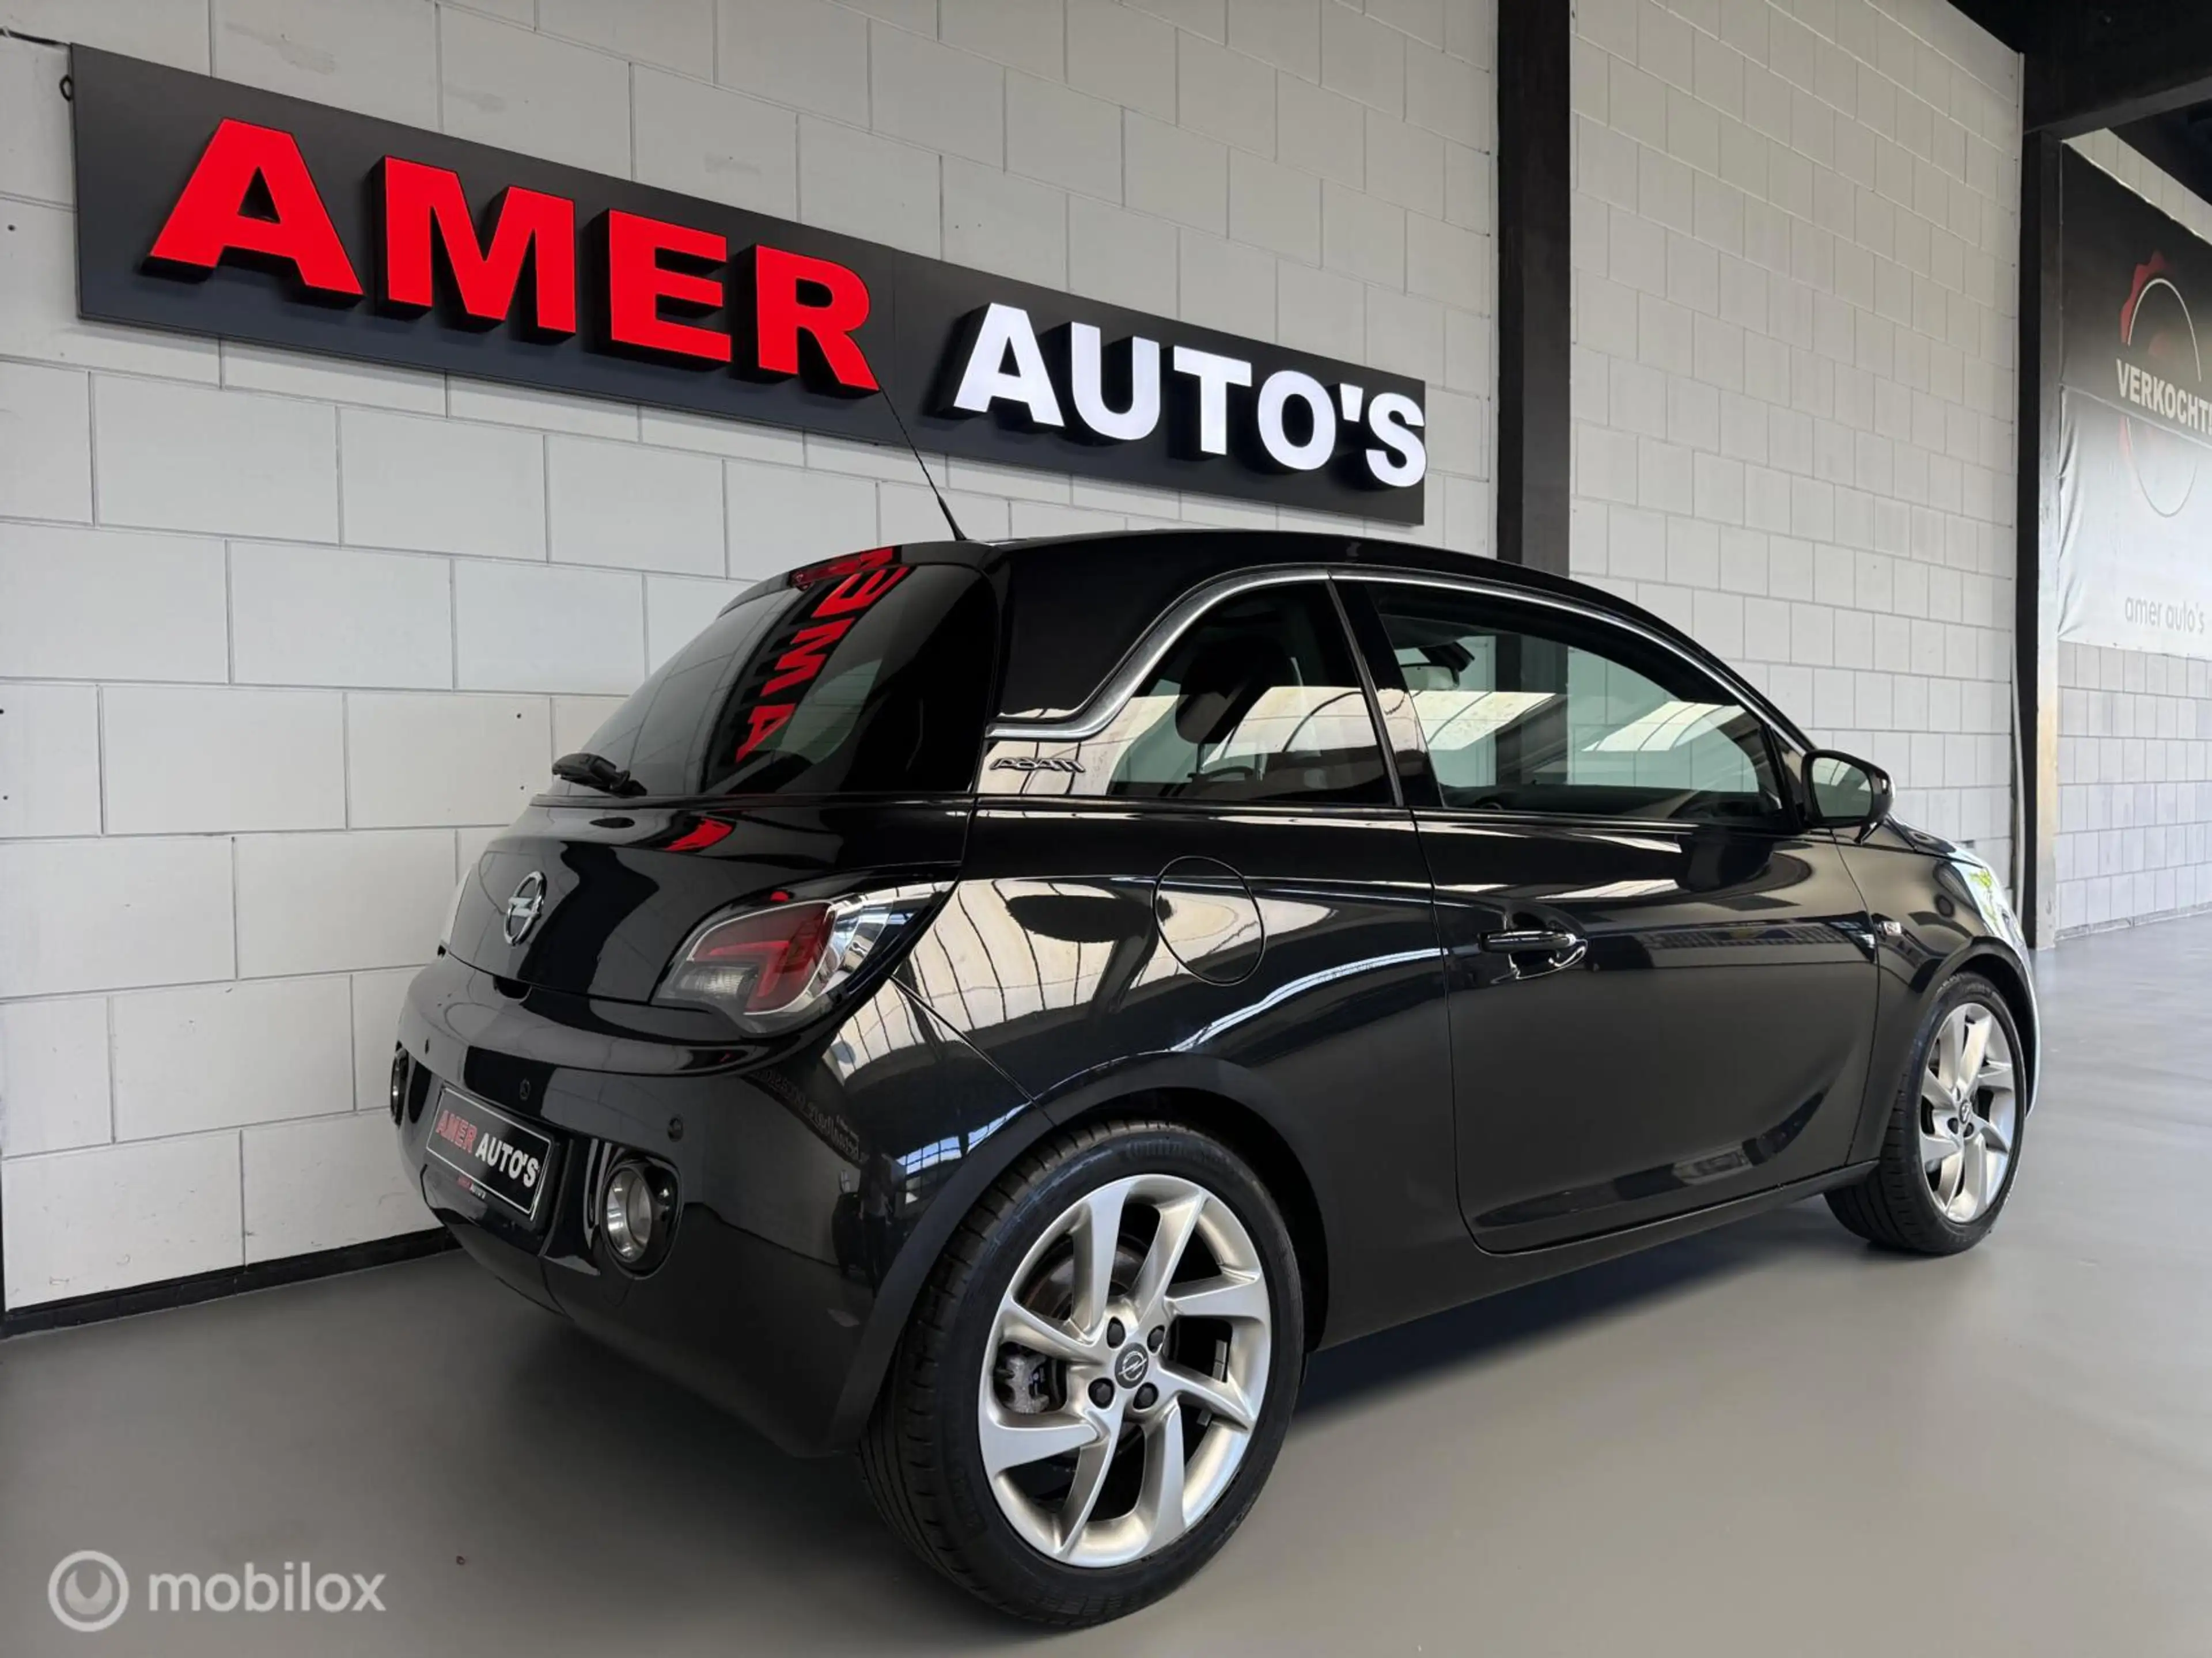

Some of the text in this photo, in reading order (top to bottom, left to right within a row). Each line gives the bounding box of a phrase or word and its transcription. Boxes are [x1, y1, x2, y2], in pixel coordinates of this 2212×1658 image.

[150, 117, 1427, 488] AMER AUTO'S
[2125, 596, 2205, 635] amer auto's
[435, 1110, 478, 1154] AMER
[475, 1132, 540, 1188] AUTO'S
